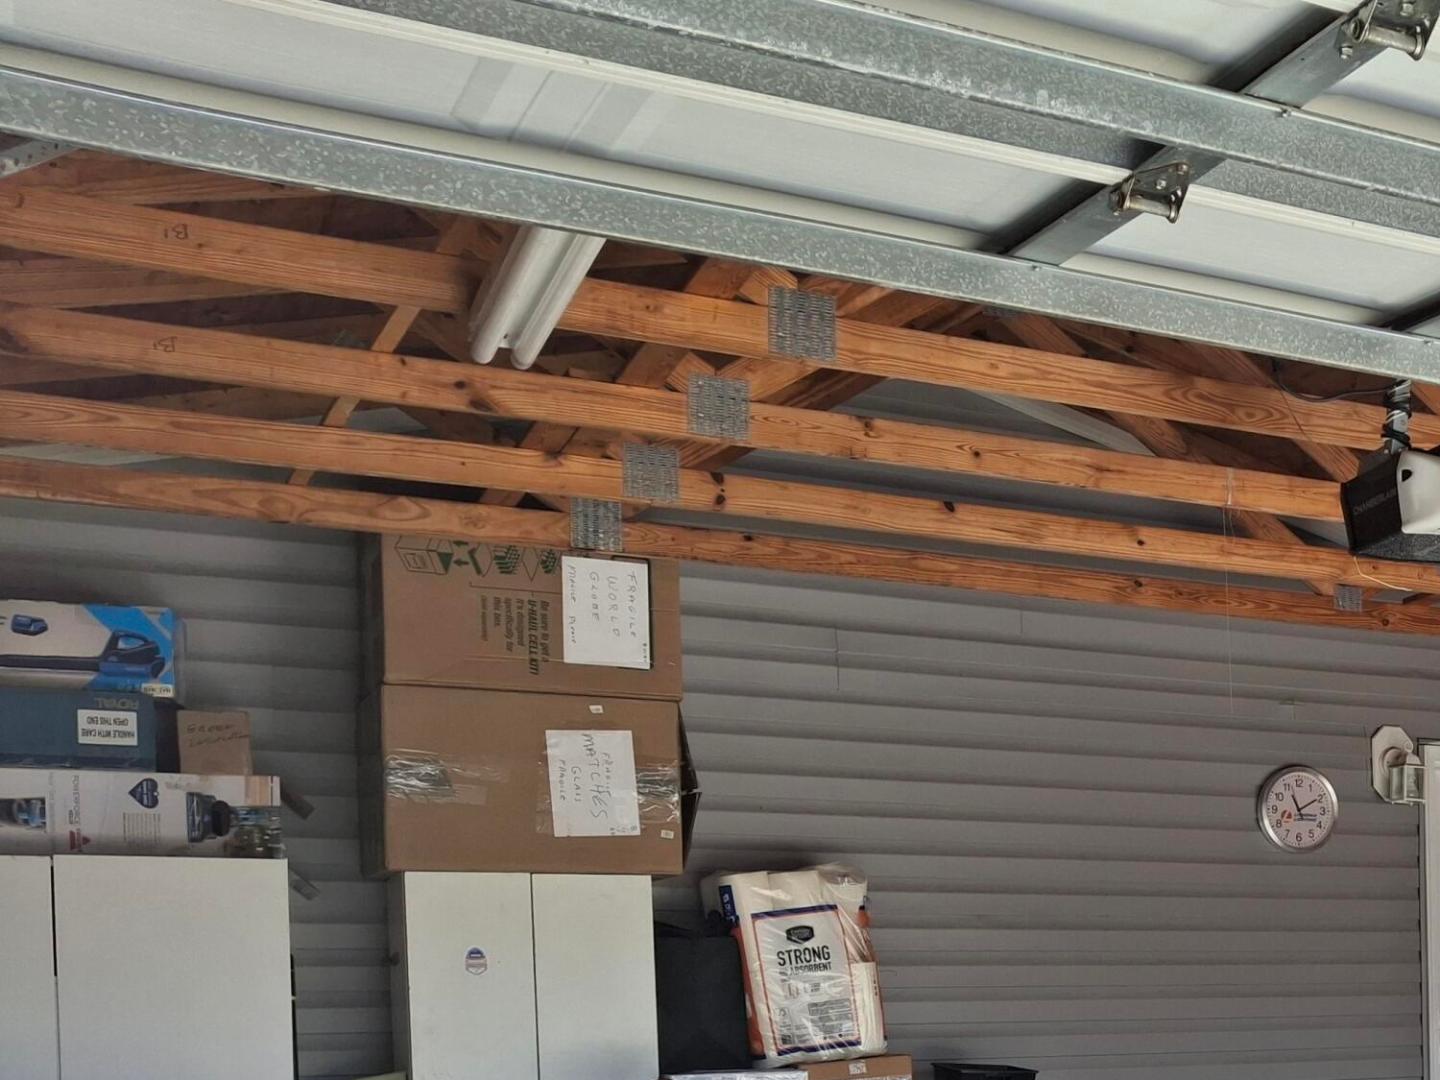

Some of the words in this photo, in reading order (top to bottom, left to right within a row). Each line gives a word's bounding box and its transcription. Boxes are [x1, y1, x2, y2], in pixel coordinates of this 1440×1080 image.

[606, 575, 621, 638] WORLD
[528, 599, 540, 633] U-HAUL
[528, 634, 539, 656] CELL
[1283, 783, 1291, 792] 11
[1295, 779, 1303, 788] 12
[1308, 784, 1313, 792] 1
[1275, 792, 1284, 802] 10
[1317, 794, 1323, 803] 2
[1271, 804, 1278, 814] 9
[1319, 807, 1326, 816] 3
[1275, 819, 1282, 828] 8
[1316, 821, 1323, 829] 4
[1285, 830, 1290, 839] 7
[1295, 832, 1303, 842] 6
[1308, 829, 1315, 839] 5
[776, 945, 832, 967] STRONG
